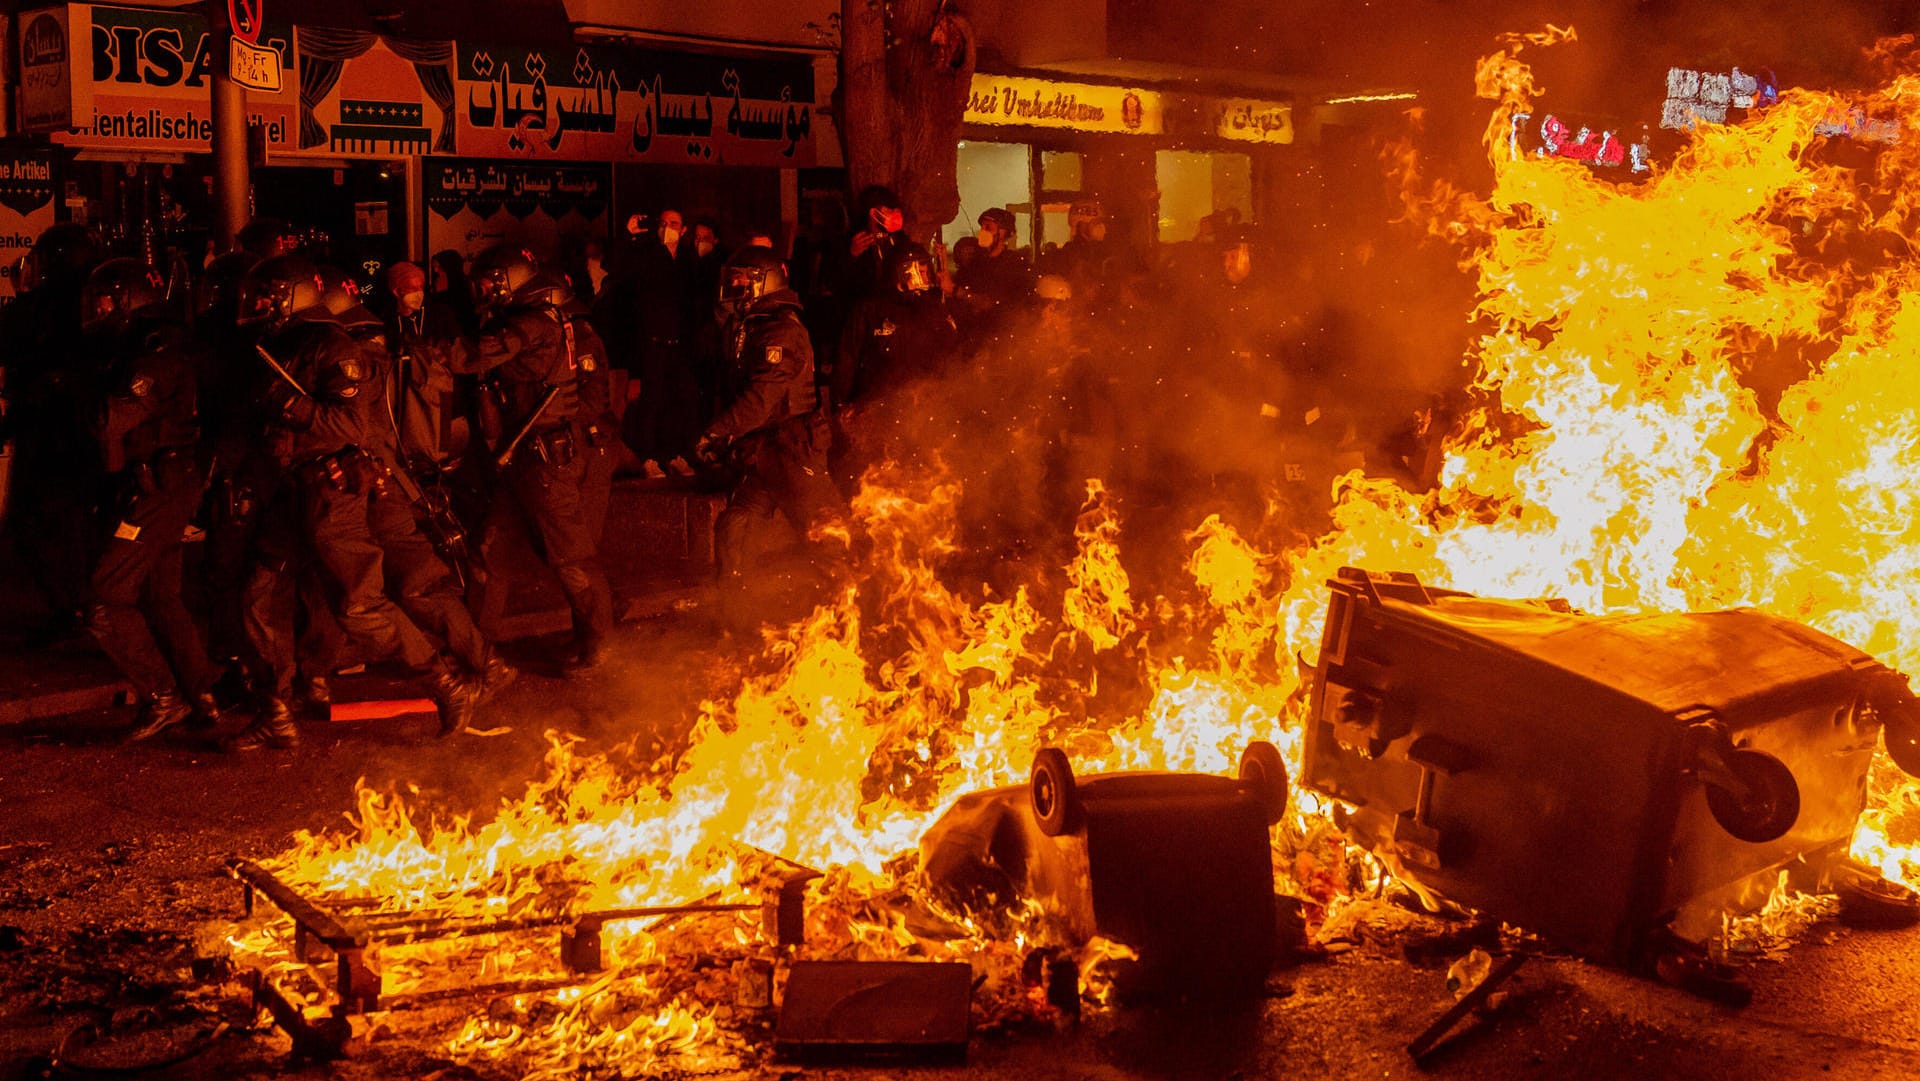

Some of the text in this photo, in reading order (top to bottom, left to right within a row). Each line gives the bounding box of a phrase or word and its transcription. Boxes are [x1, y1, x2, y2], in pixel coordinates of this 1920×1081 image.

[68, 107, 212, 140] ientalische
[468, 48, 620, 152] للشرقيات
[632, 75, 713, 158] بيسان
[13, 159, 51, 181] Artikel
